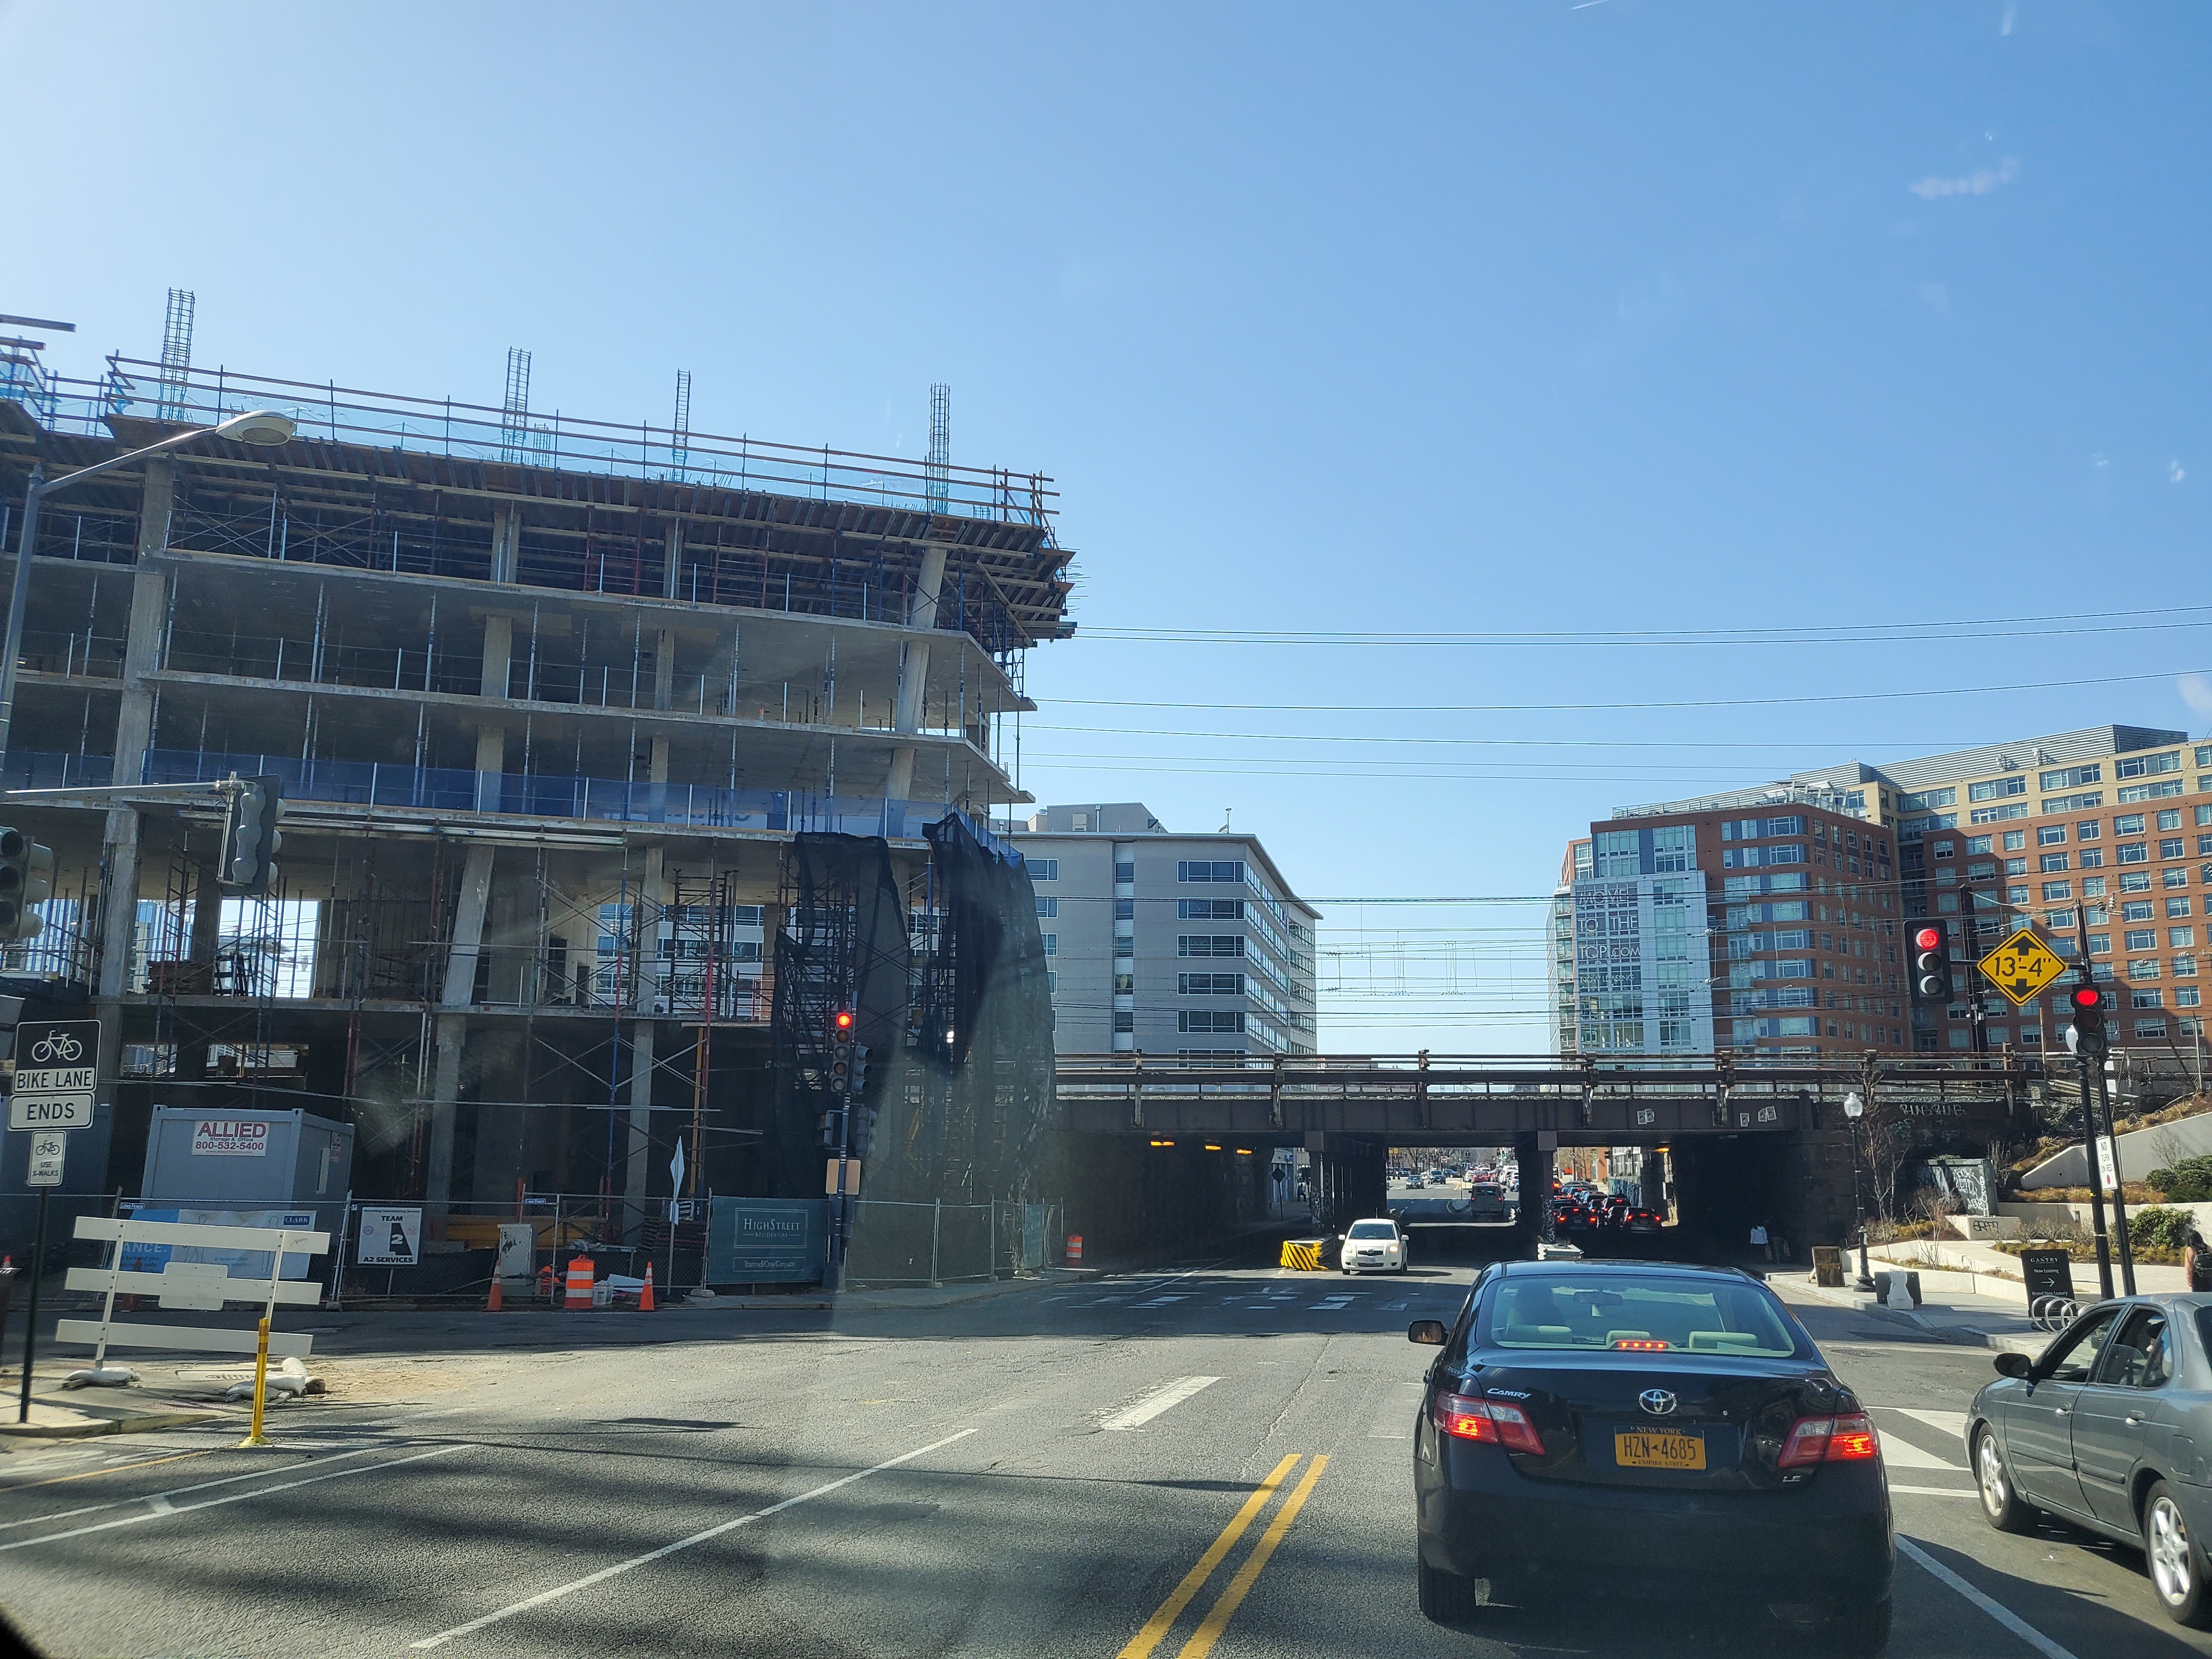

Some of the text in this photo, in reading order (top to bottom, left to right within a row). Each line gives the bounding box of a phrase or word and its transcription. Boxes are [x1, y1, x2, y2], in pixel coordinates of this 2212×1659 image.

[1579, 889, 1627, 905] MOVE
[1577, 916, 1638, 932] TO THE
[1602, 974, 1634, 983] LEASING
[16, 1070, 92, 1089] BIKE LANE
[27, 1102, 75, 1120] ENDS
[198, 1122, 266, 1138] ALLIED
[195, 1141, 264, 1150] 800-532-5400
[2101, 1142, 2107, 1152] NO
[2101, 1154, 2110, 1162] TURN
[2101, 1165, 2106, 1173] ON
[391, 1234, 403, 1244] 2
